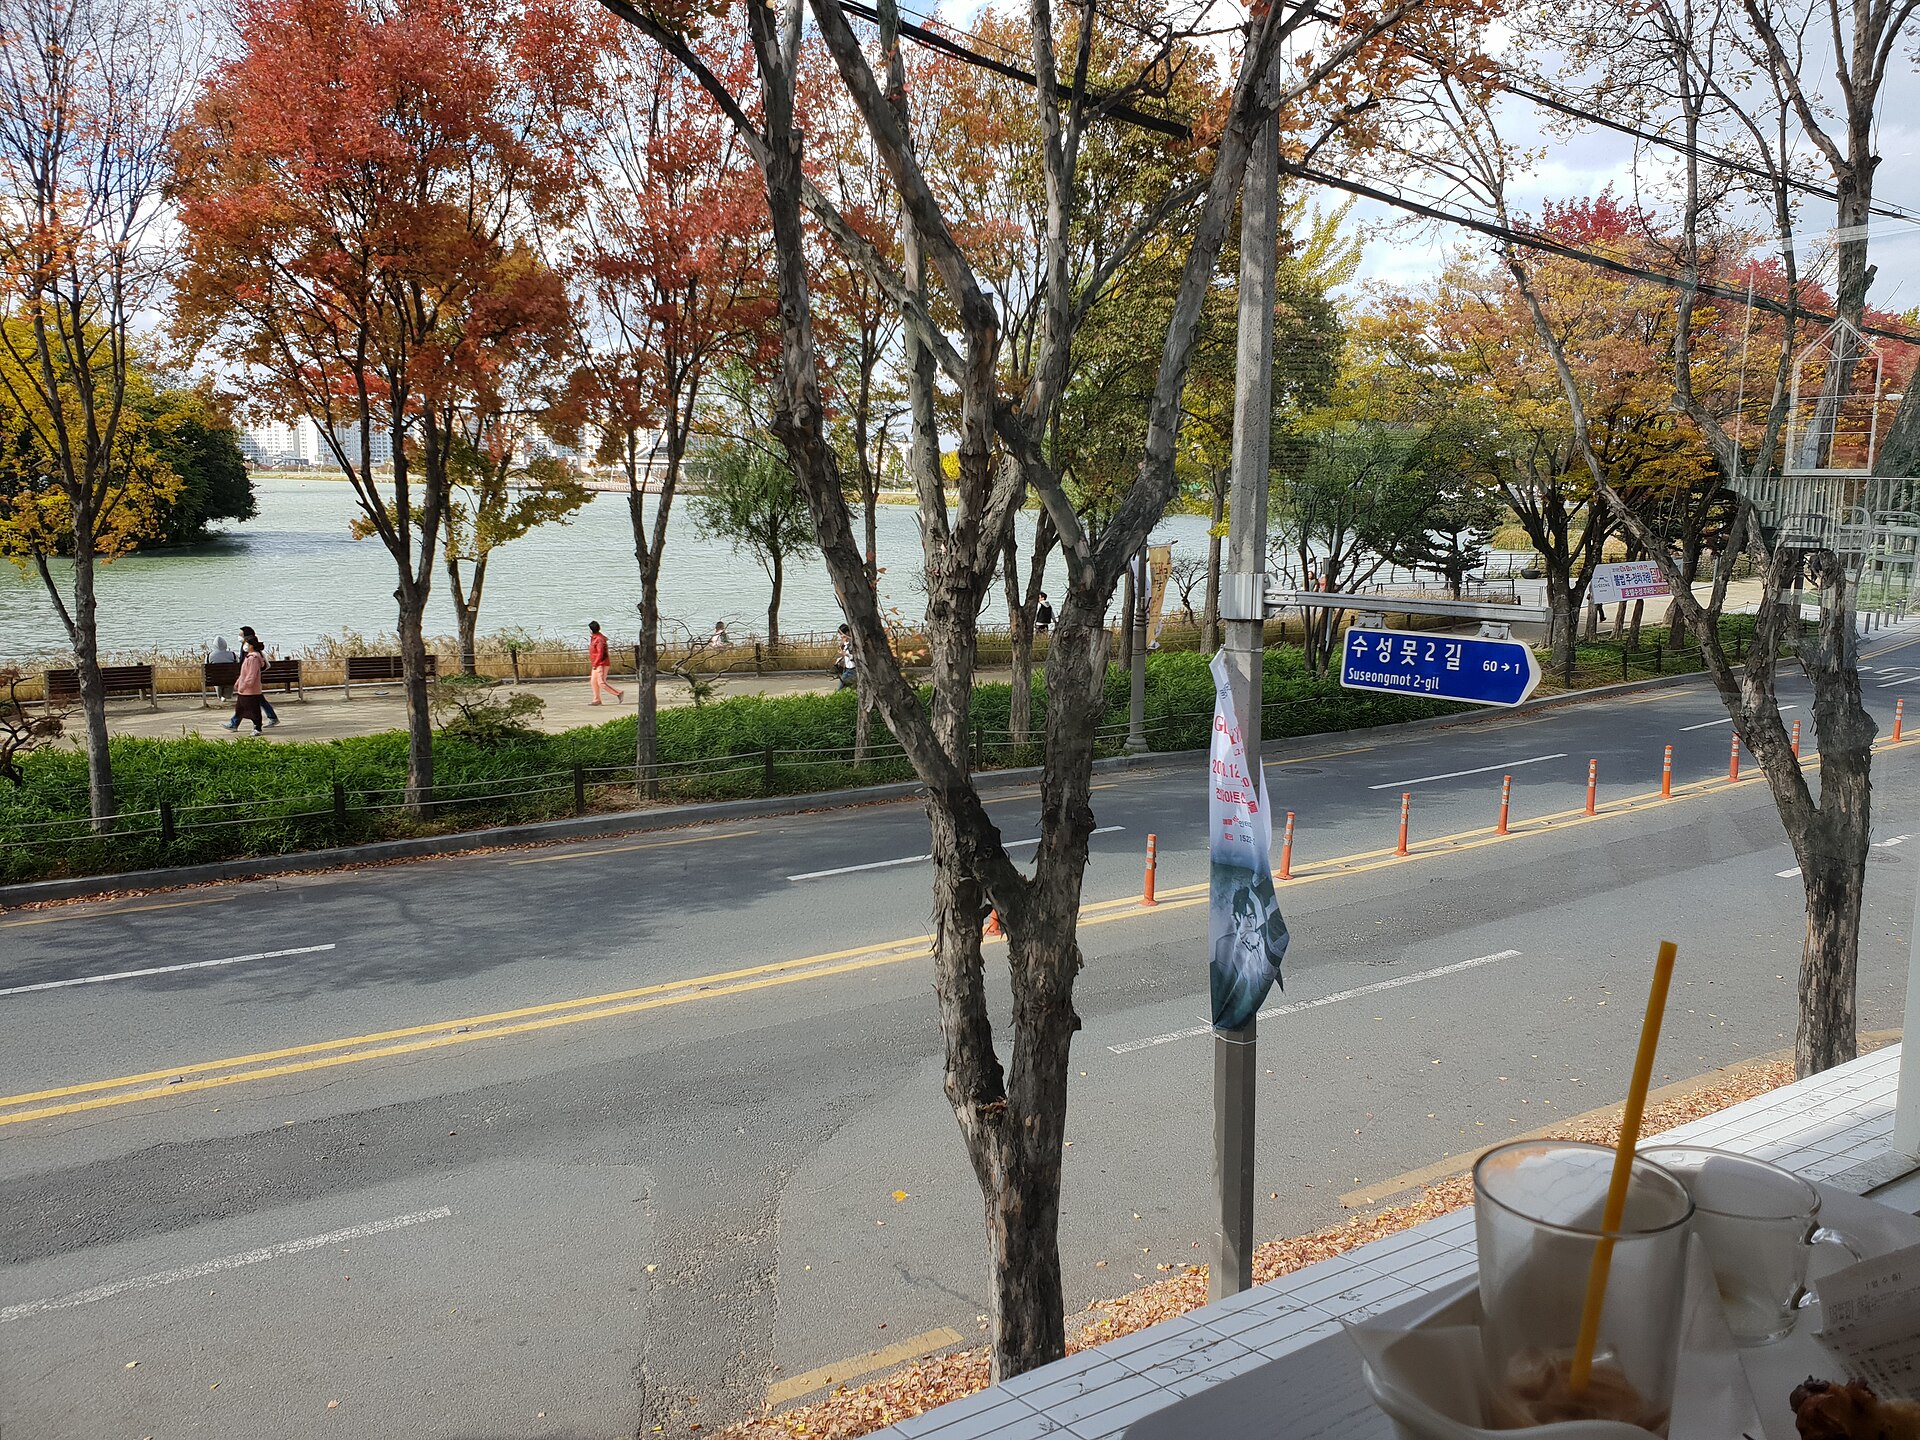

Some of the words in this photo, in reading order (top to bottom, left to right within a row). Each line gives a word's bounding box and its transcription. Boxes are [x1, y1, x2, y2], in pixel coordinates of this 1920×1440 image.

[1482, 660, 1498, 672] 60
[1514, 663, 1520, 675] 1
[1347, 667, 1411, 687] Suseongmot
[1413, 674, 1440, 692] 2-gil
